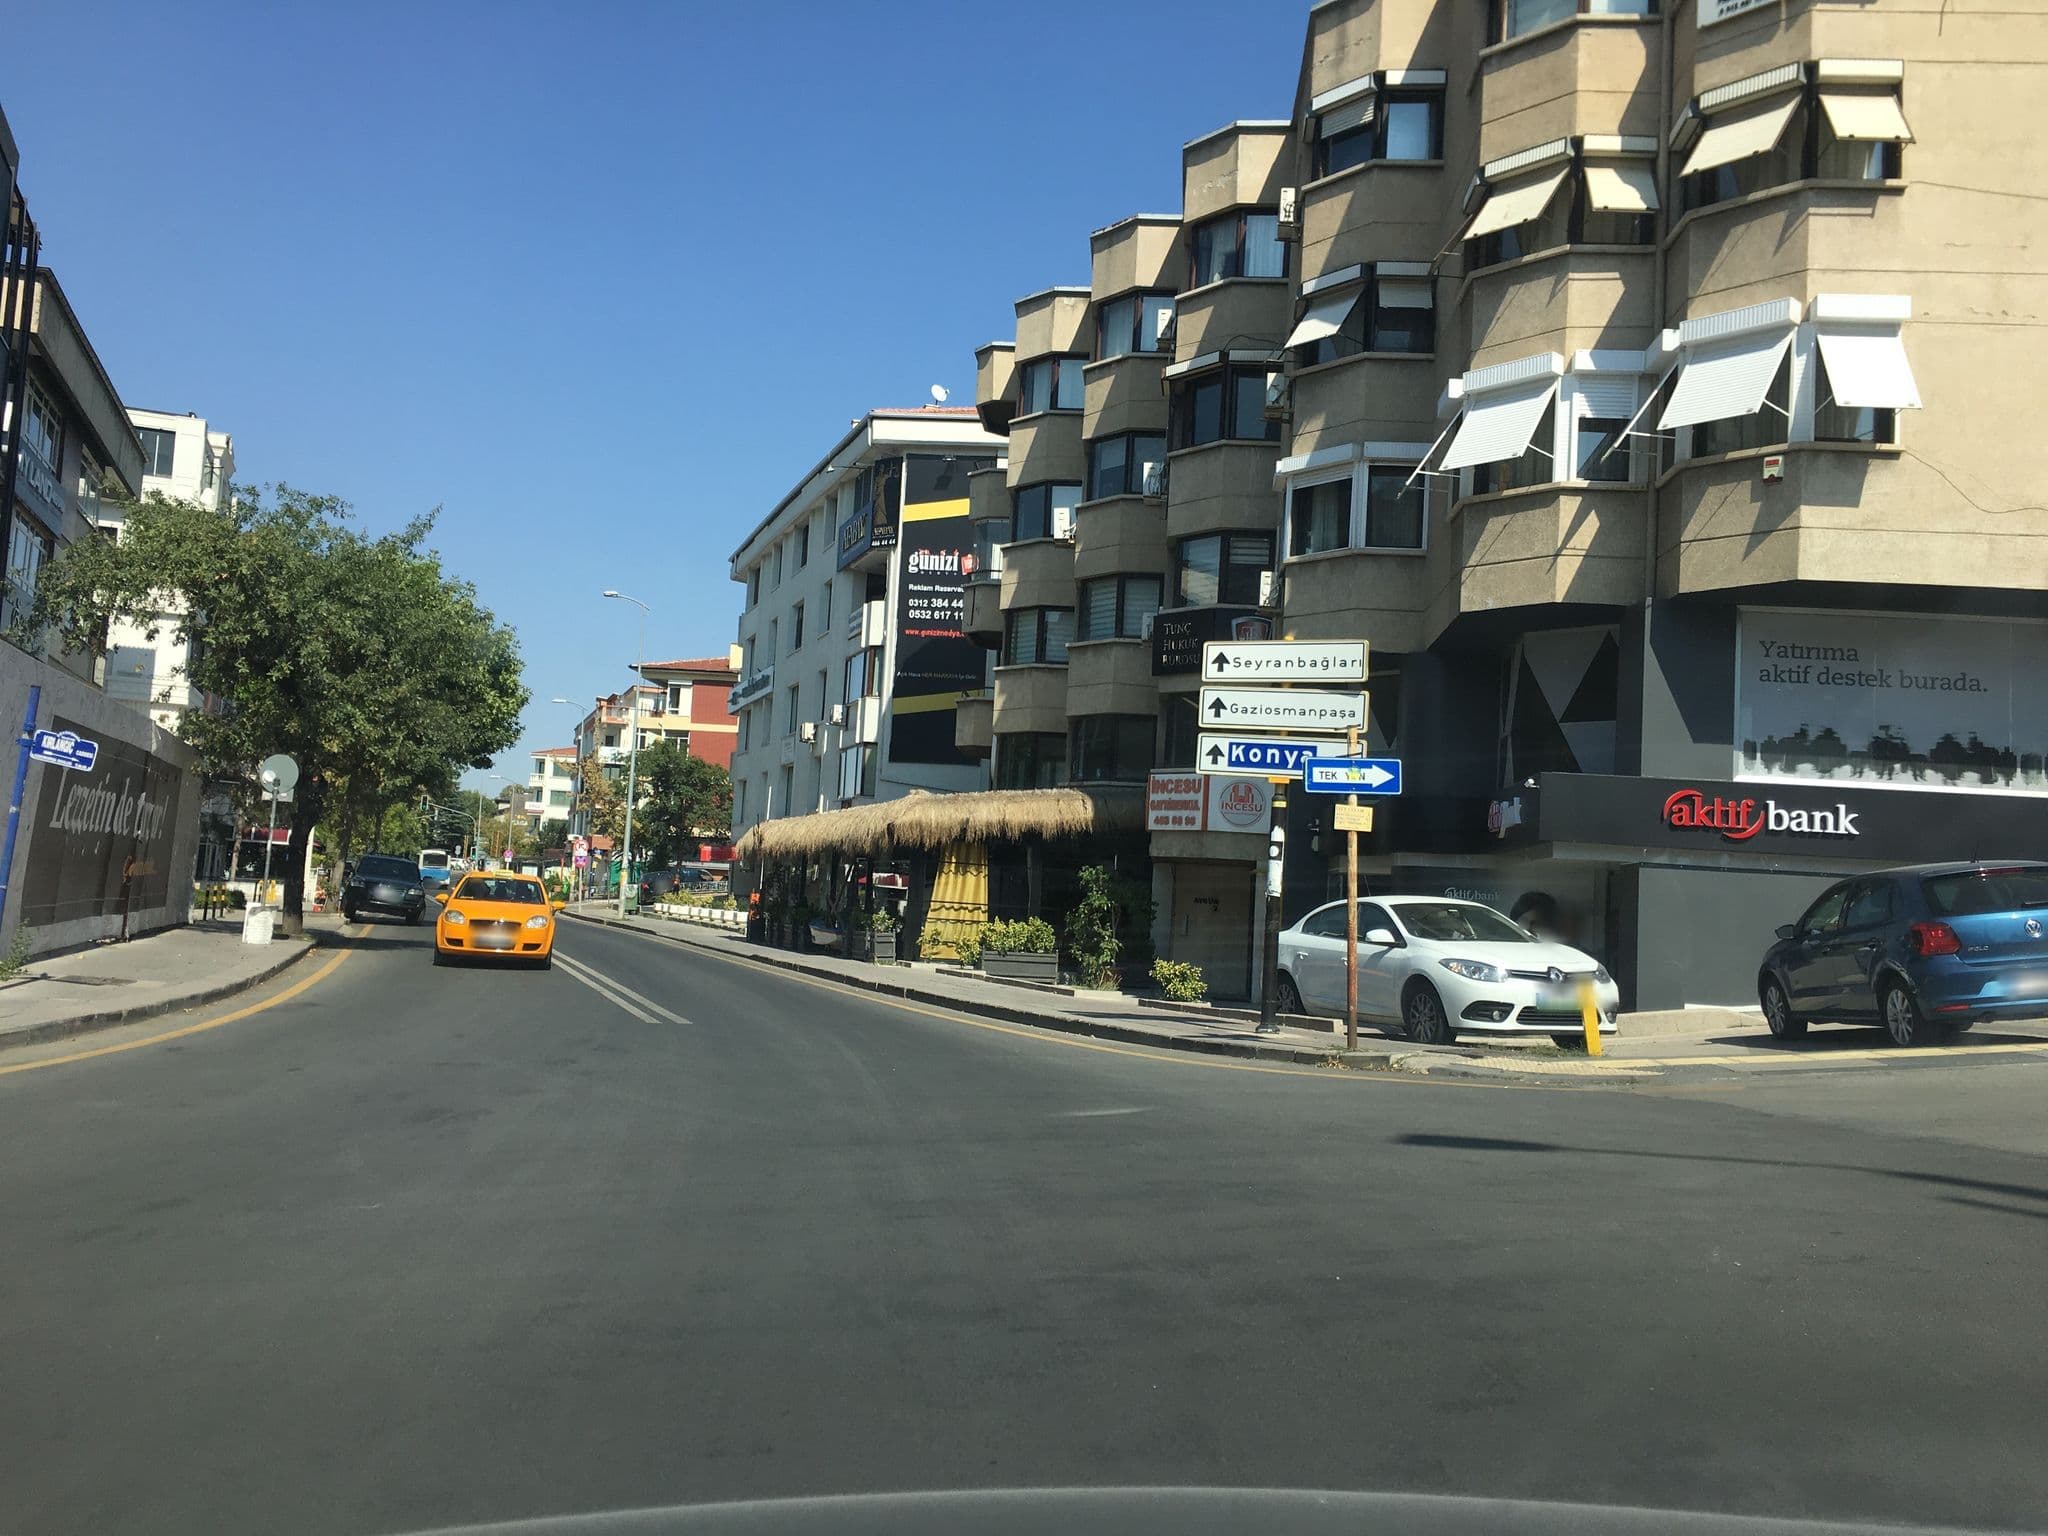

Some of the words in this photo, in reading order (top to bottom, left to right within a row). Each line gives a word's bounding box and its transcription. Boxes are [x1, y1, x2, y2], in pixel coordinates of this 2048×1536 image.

[908, 598, 929, 608] 0312
[930, 598, 949, 609] 384
[950, 598, 964, 609] 44
[908, 609, 932, 620] 0532
[933, 610, 952, 620] 617
[1758, 640, 1860, 662] Yatırıma
[1232, 656, 1362, 671] Seyranbağları
[1758, 664, 1813, 685] aktif
[1816, 666, 1893, 688] destek
[1900, 670, 1989, 693] burada.
[1229, 703, 1356, 720] Gaziosmanpaşa
[1319, 771, 1338, 780] TEK
[1345, 772, 1366, 781] YN
[113, 777, 134, 836] de
[1667, 791, 1759, 832] aktif
[1766, 800, 1861, 836] bank
